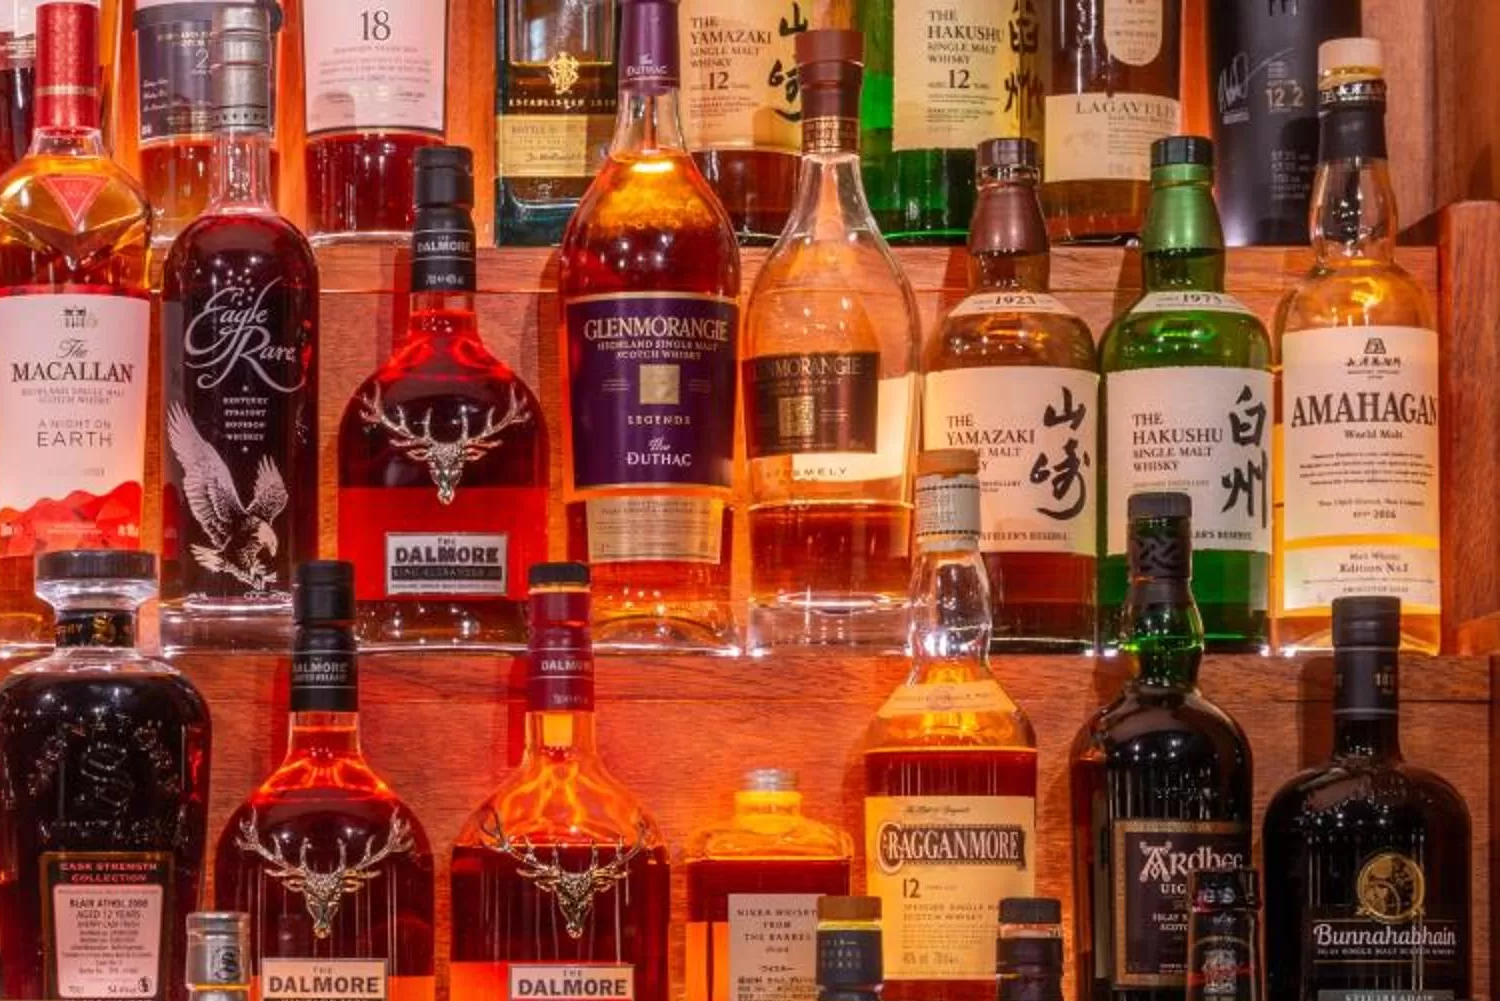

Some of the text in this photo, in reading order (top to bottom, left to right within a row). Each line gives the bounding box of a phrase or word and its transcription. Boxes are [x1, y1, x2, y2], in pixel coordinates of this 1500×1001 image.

[360, 11, 391, 41] 18
[691, 31, 771, 44] YAMAZAKI
[708, 72, 728, 89] 12
[948, 69, 970, 89] 12
[584, 316, 728, 341] GLENMORANGIE
[12, 362, 135, 384] MACALLAN
[1291, 392, 1437, 428] AMAHAGAN
[52, 420, 90, 429] NIGHT
[947, 415, 973, 427] THE
[1132, 413, 1164, 427] THE
[36, 431, 114, 448] EARTH
[947, 430, 1035, 445] YAMAZAKI
[1132, 428, 1223, 445] HAKUSHU
[626, 451, 692, 467] DUTHAC
[1133, 447, 1213, 458] SINGLE MALT
[1133, 459, 1180, 472] WHISKY
[394, 546, 500, 565] DALMORE
[878, 822, 1019, 872] CRAGGANMORE
[902, 878, 921, 898] 12
[1313, 923, 1457, 948] Bunnahabhain
[268, 976, 381, 993] DALMORE
[518, 979, 628, 996] DALMORE
